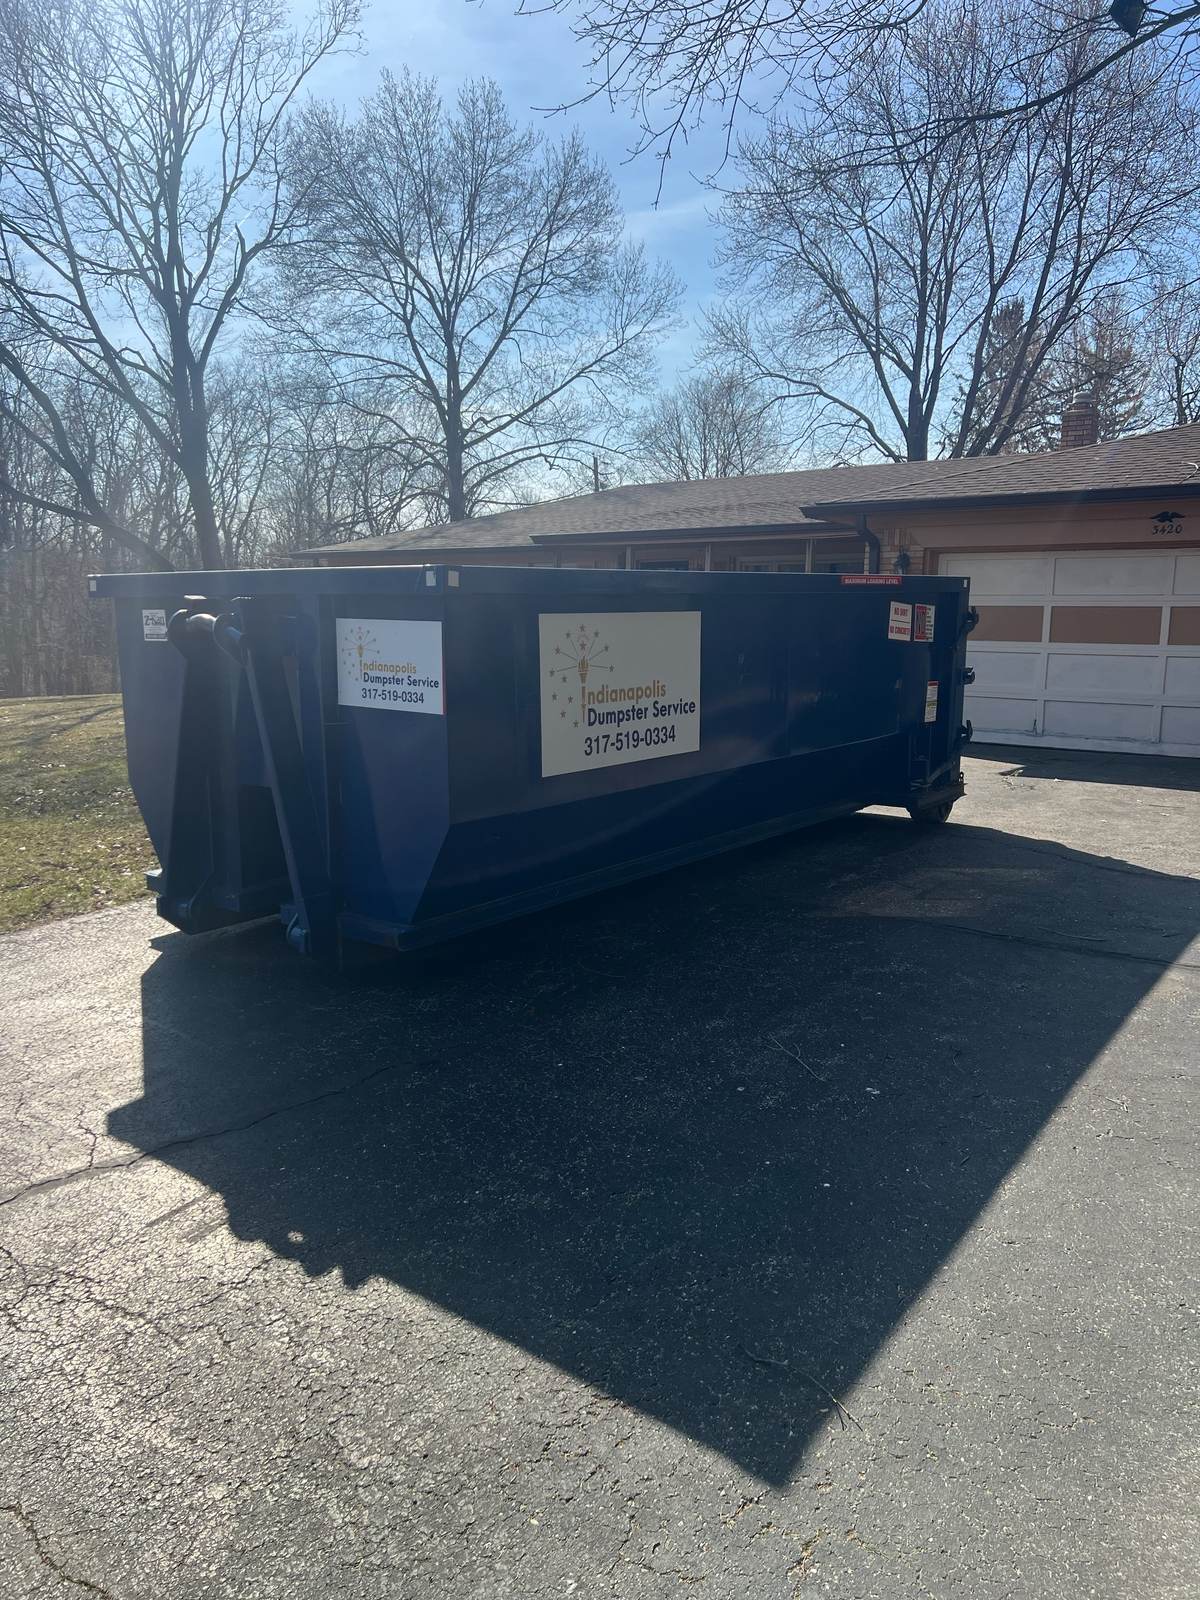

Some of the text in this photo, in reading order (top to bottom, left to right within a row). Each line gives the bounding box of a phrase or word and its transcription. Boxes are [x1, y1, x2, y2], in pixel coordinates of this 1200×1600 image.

[360, 660, 417, 675] Indianapolis
[363, 672, 439, 688] Dumpster Service
[361, 687, 424, 703] 317-519-0334
[581, 679, 666, 705] Indianapolis
[587, 698, 696, 727] Dumpster Service
[584, 724, 676, 756] 317-519-0334
